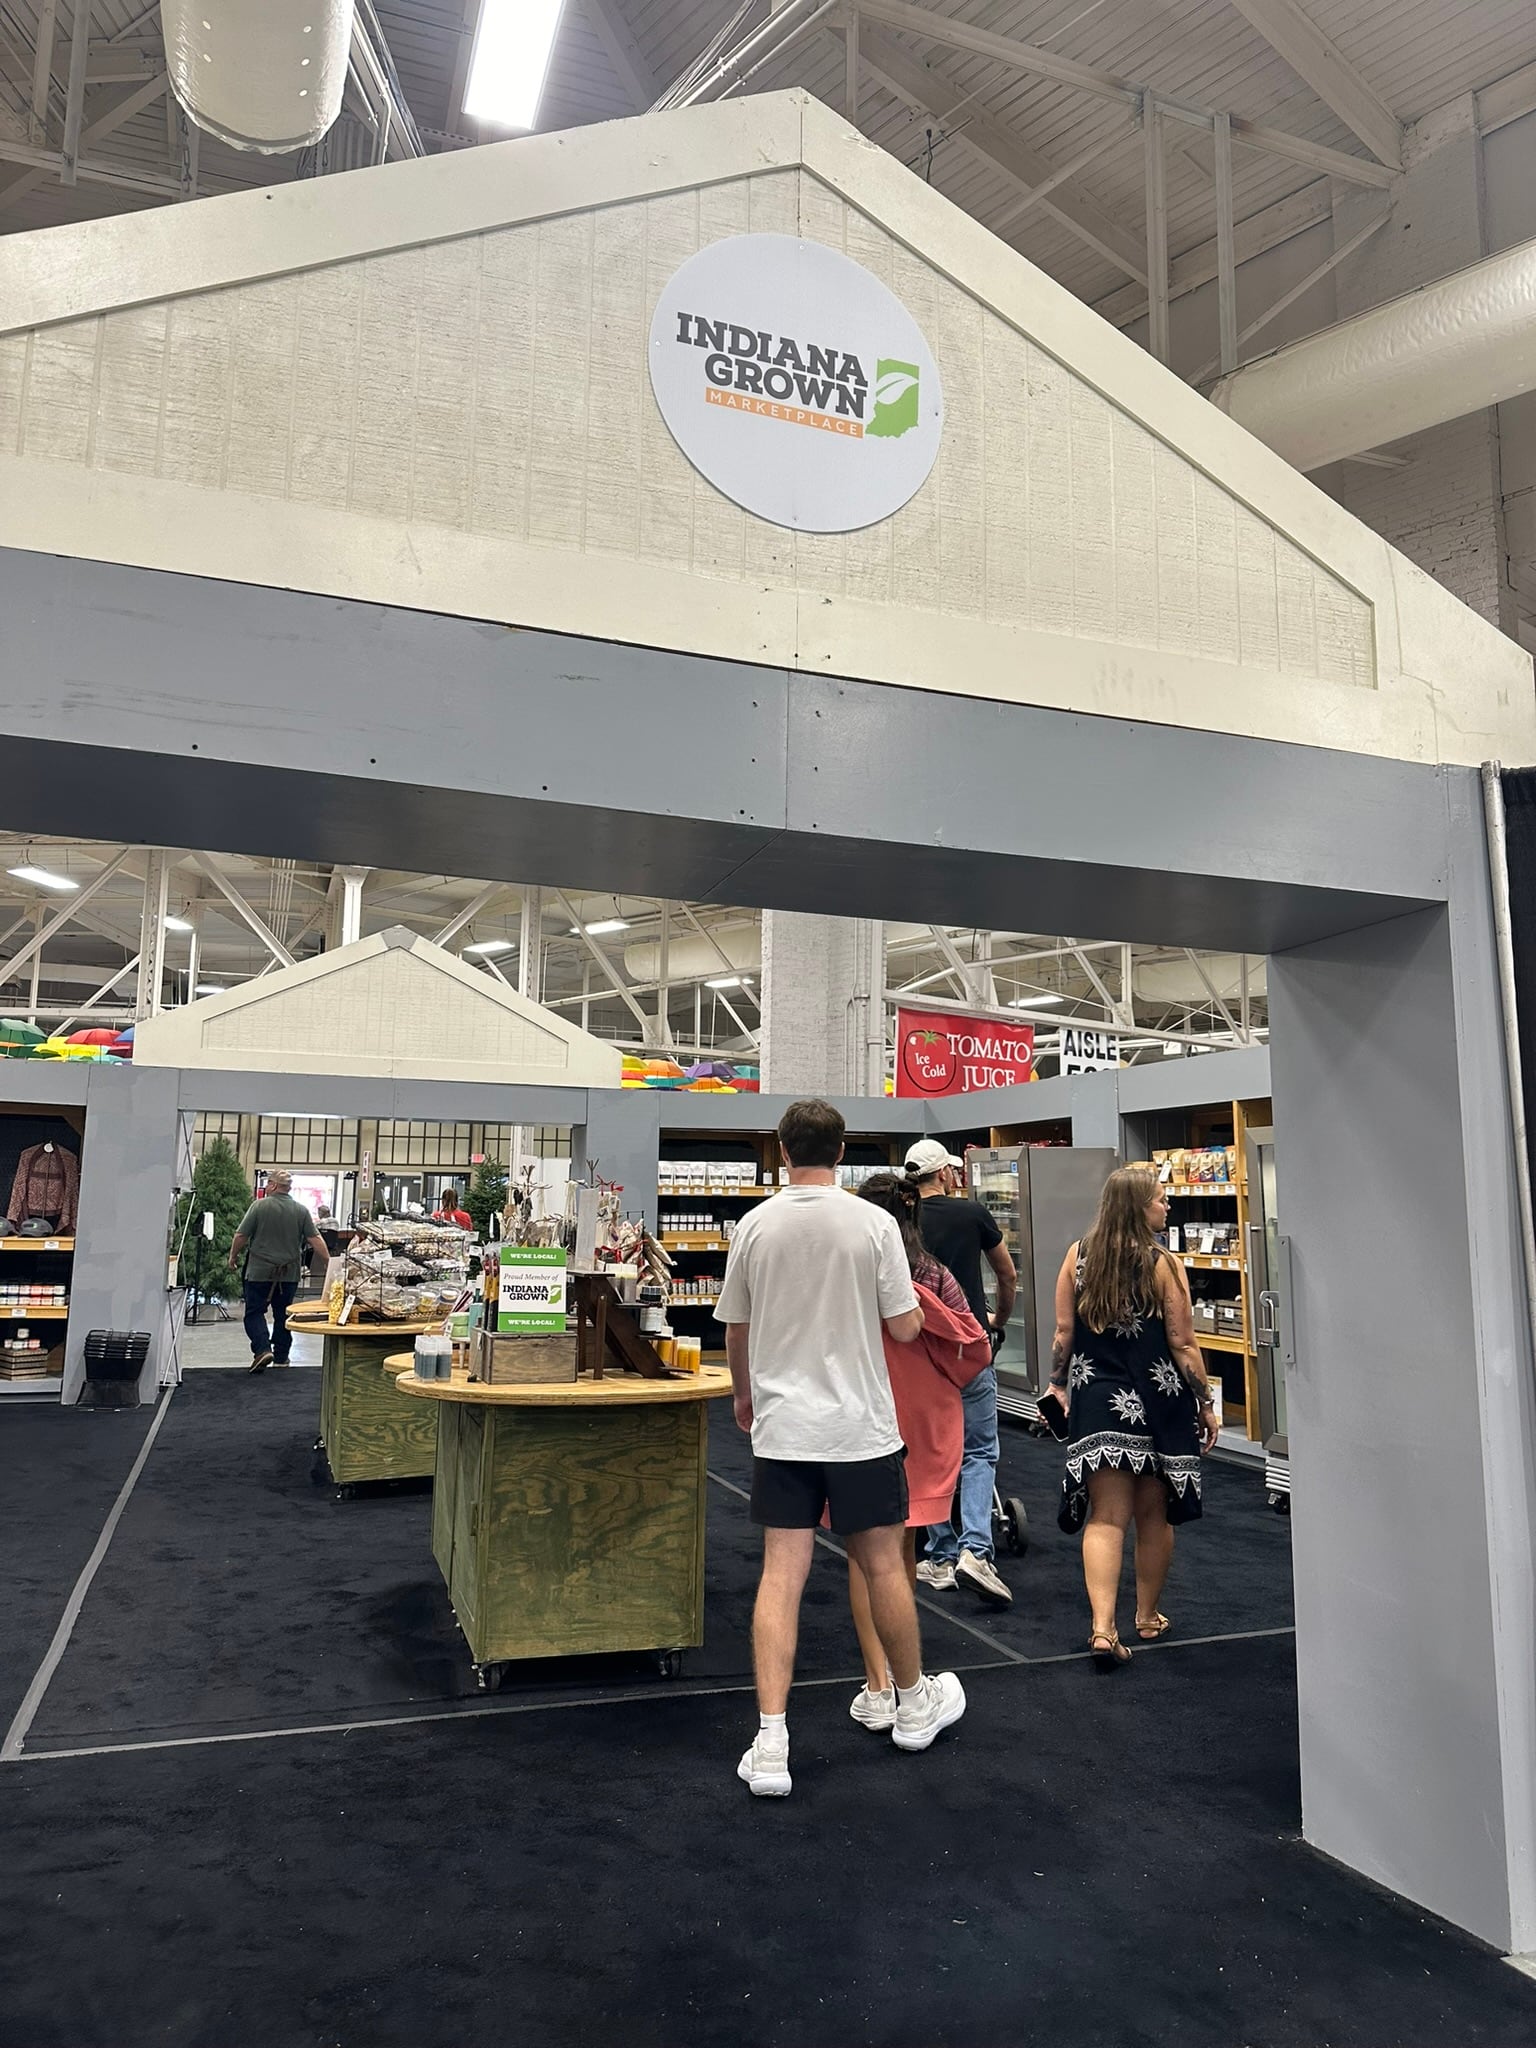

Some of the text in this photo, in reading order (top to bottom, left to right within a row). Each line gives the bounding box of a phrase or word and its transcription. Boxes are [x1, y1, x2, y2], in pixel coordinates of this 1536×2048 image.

[677, 311, 868, 388] INDIANA
[705, 353, 867, 419] GROWN
[710, 390, 857, 435] MARKETPLACE
[915, 1053, 930, 1065] Ice
[947, 1033, 1031, 1063] TOMATO
[1064, 1029, 1117, 1061] AISLE
[922, 1064, 947, 1078] Cold
[962, 1065, 1015, 1091] JUICE
[503, 1285, 549, 1293] INDIANA
